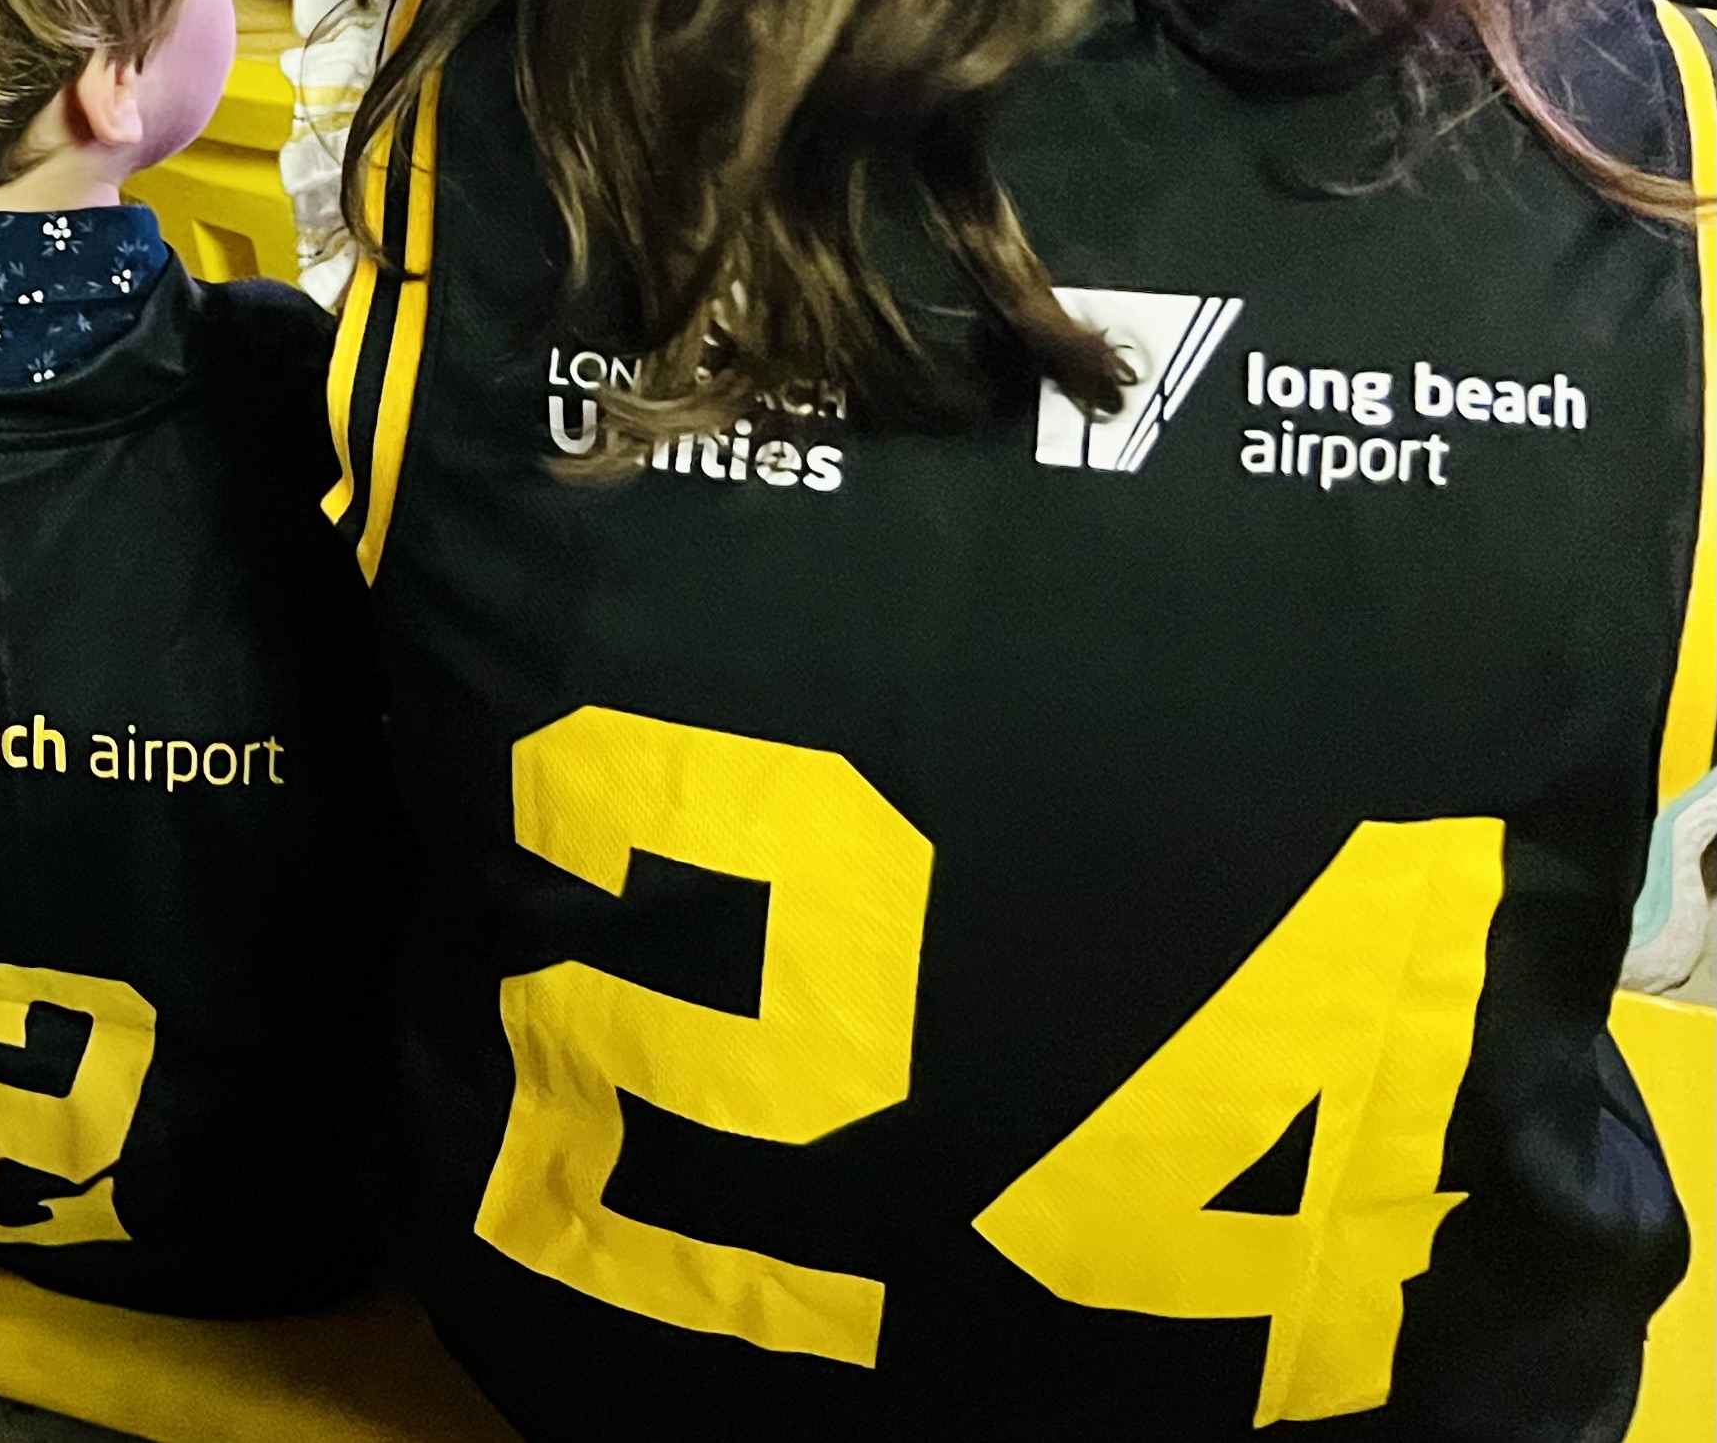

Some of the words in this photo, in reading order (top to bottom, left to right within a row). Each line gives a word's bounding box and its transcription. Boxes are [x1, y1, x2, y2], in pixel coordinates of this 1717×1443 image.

[548, 346, 643, 397] LON
[1247, 351, 1394, 426] long
[1413, 361, 1588, 430] beach
[548, 395, 845, 493] Ulities
[1240, 420, 1450, 491] airport
[90, 724, 285, 792] airport
[473, 704, 1506, 1430] 24
